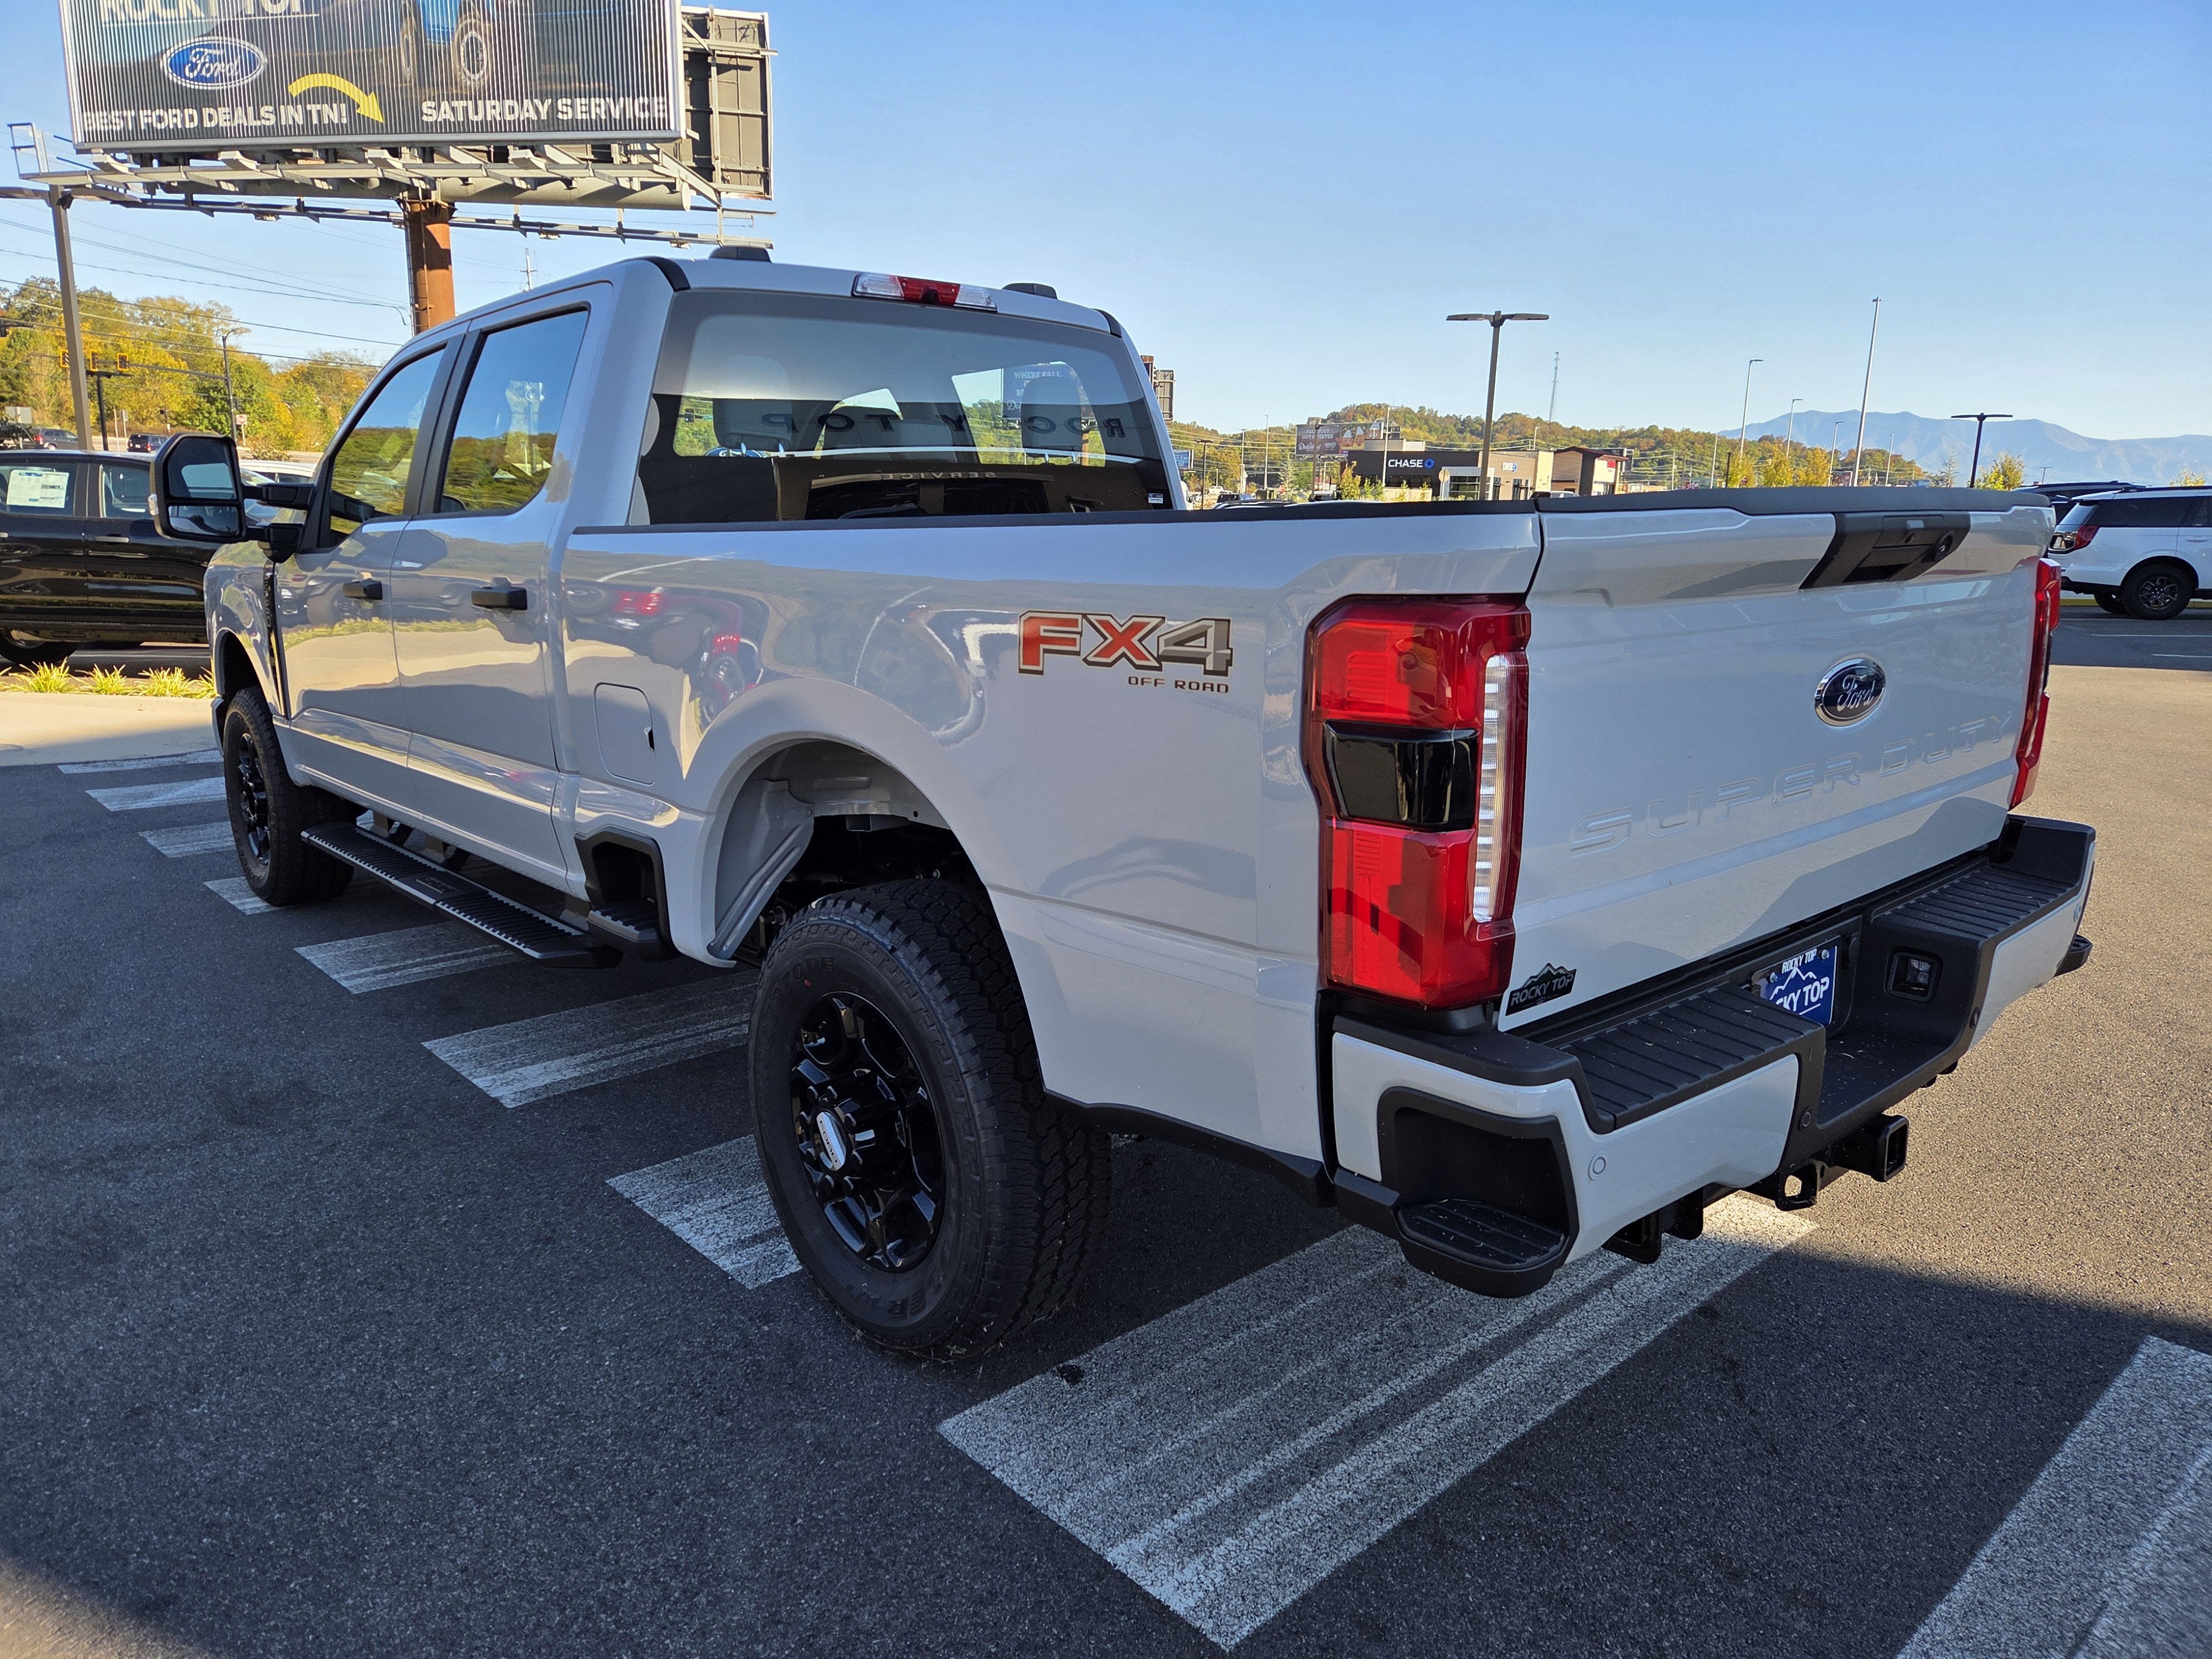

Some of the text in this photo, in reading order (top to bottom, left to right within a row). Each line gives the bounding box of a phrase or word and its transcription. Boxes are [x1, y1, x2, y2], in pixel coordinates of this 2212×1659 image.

[185, 48, 241, 79] Ford
[84, 103, 347, 131] BEST FORD DEALS IN TN!
[421, 96, 666, 122] SATURDAY SERVICE
[1388, 459, 1423, 468] CHASE
[1018, 610, 1233, 677] FX4
[1128, 676, 1229, 693] OFF ROAD
[1837, 674, 1875, 712] Ford
[1569, 710, 2012, 859] SUPER DUTY
[1782, 948, 1817, 974] ROCKY TOP
[1511, 974, 1574, 1006] ROCKY TOP
[1803, 977, 1830, 1006] TOP
